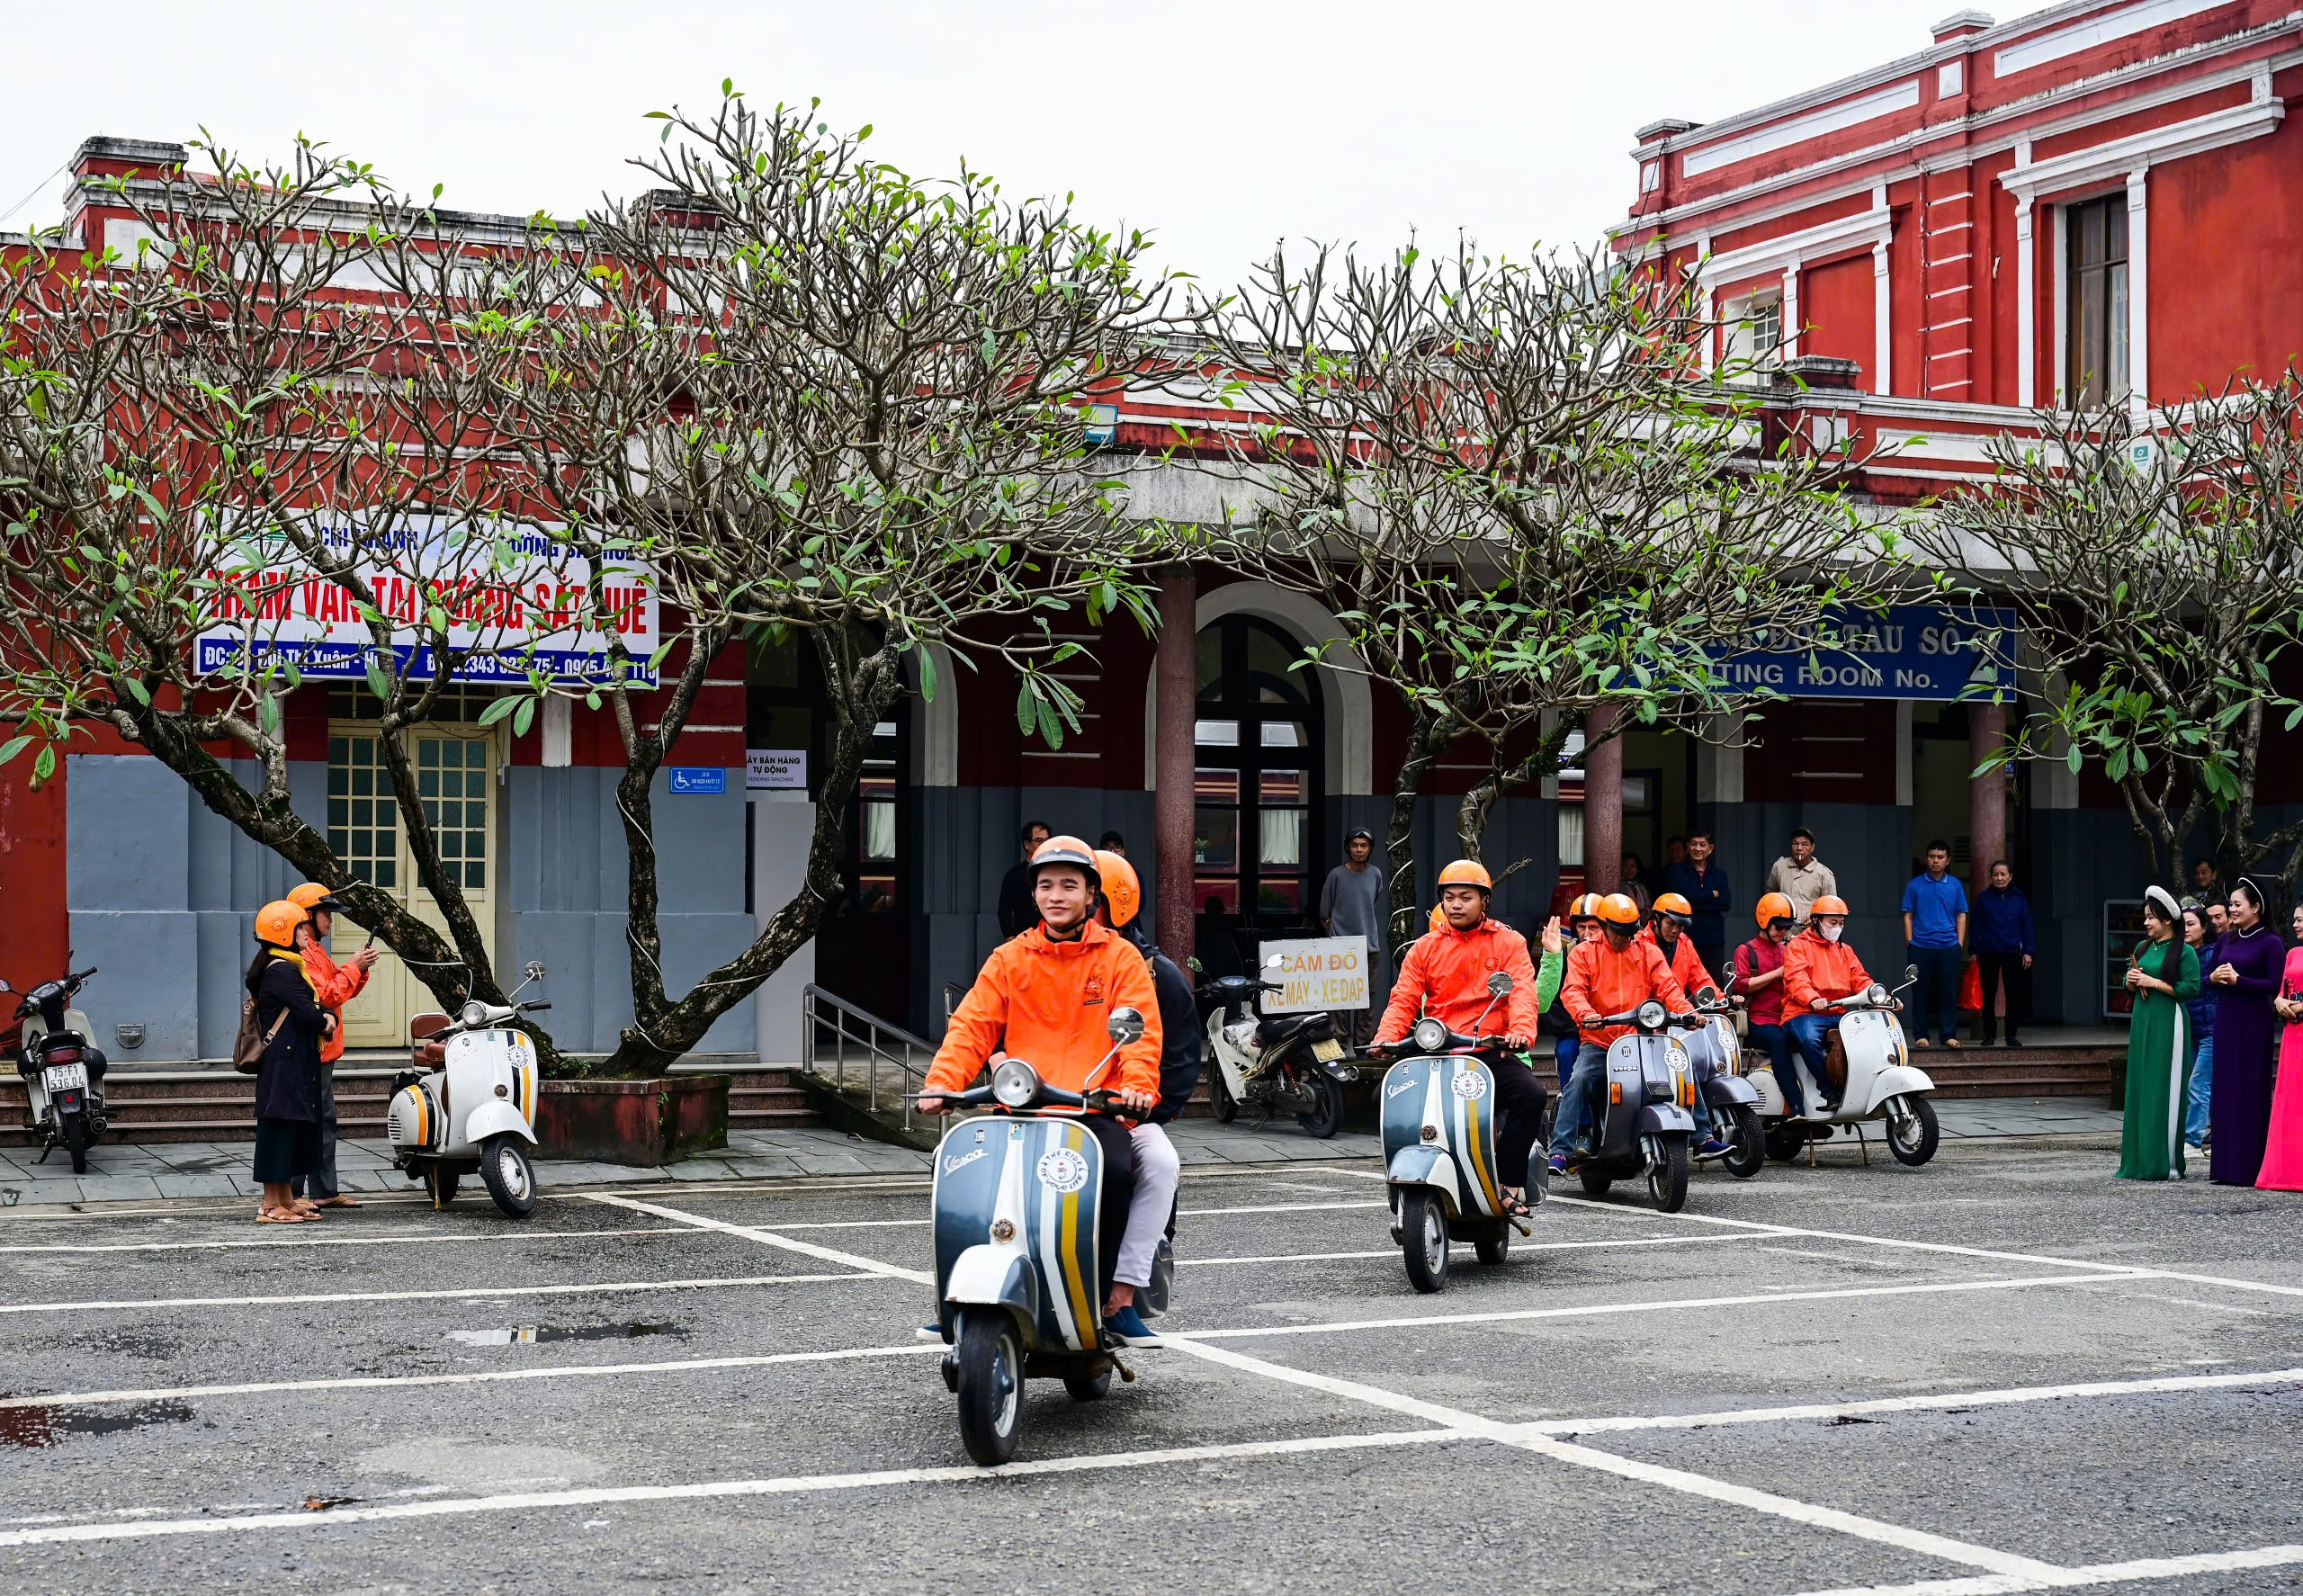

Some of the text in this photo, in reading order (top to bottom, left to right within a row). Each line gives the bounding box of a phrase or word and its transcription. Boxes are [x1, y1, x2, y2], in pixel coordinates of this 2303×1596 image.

[320, 526, 348, 547] CHI
[1842, 614, 1904, 653] TÀU
[1797, 665, 1882, 687] ROOM
[1895, 668, 1939, 689] No.
[746, 756, 801, 765] ÁY BÁN HÀNG
[753, 766, 788, 776] TỰ ĐỘNG
[52, 1065, 78, 1078] 75-F1
[1387, 1079, 1419, 1100] Vespa
[944, 1148, 990, 1178] Vespa
